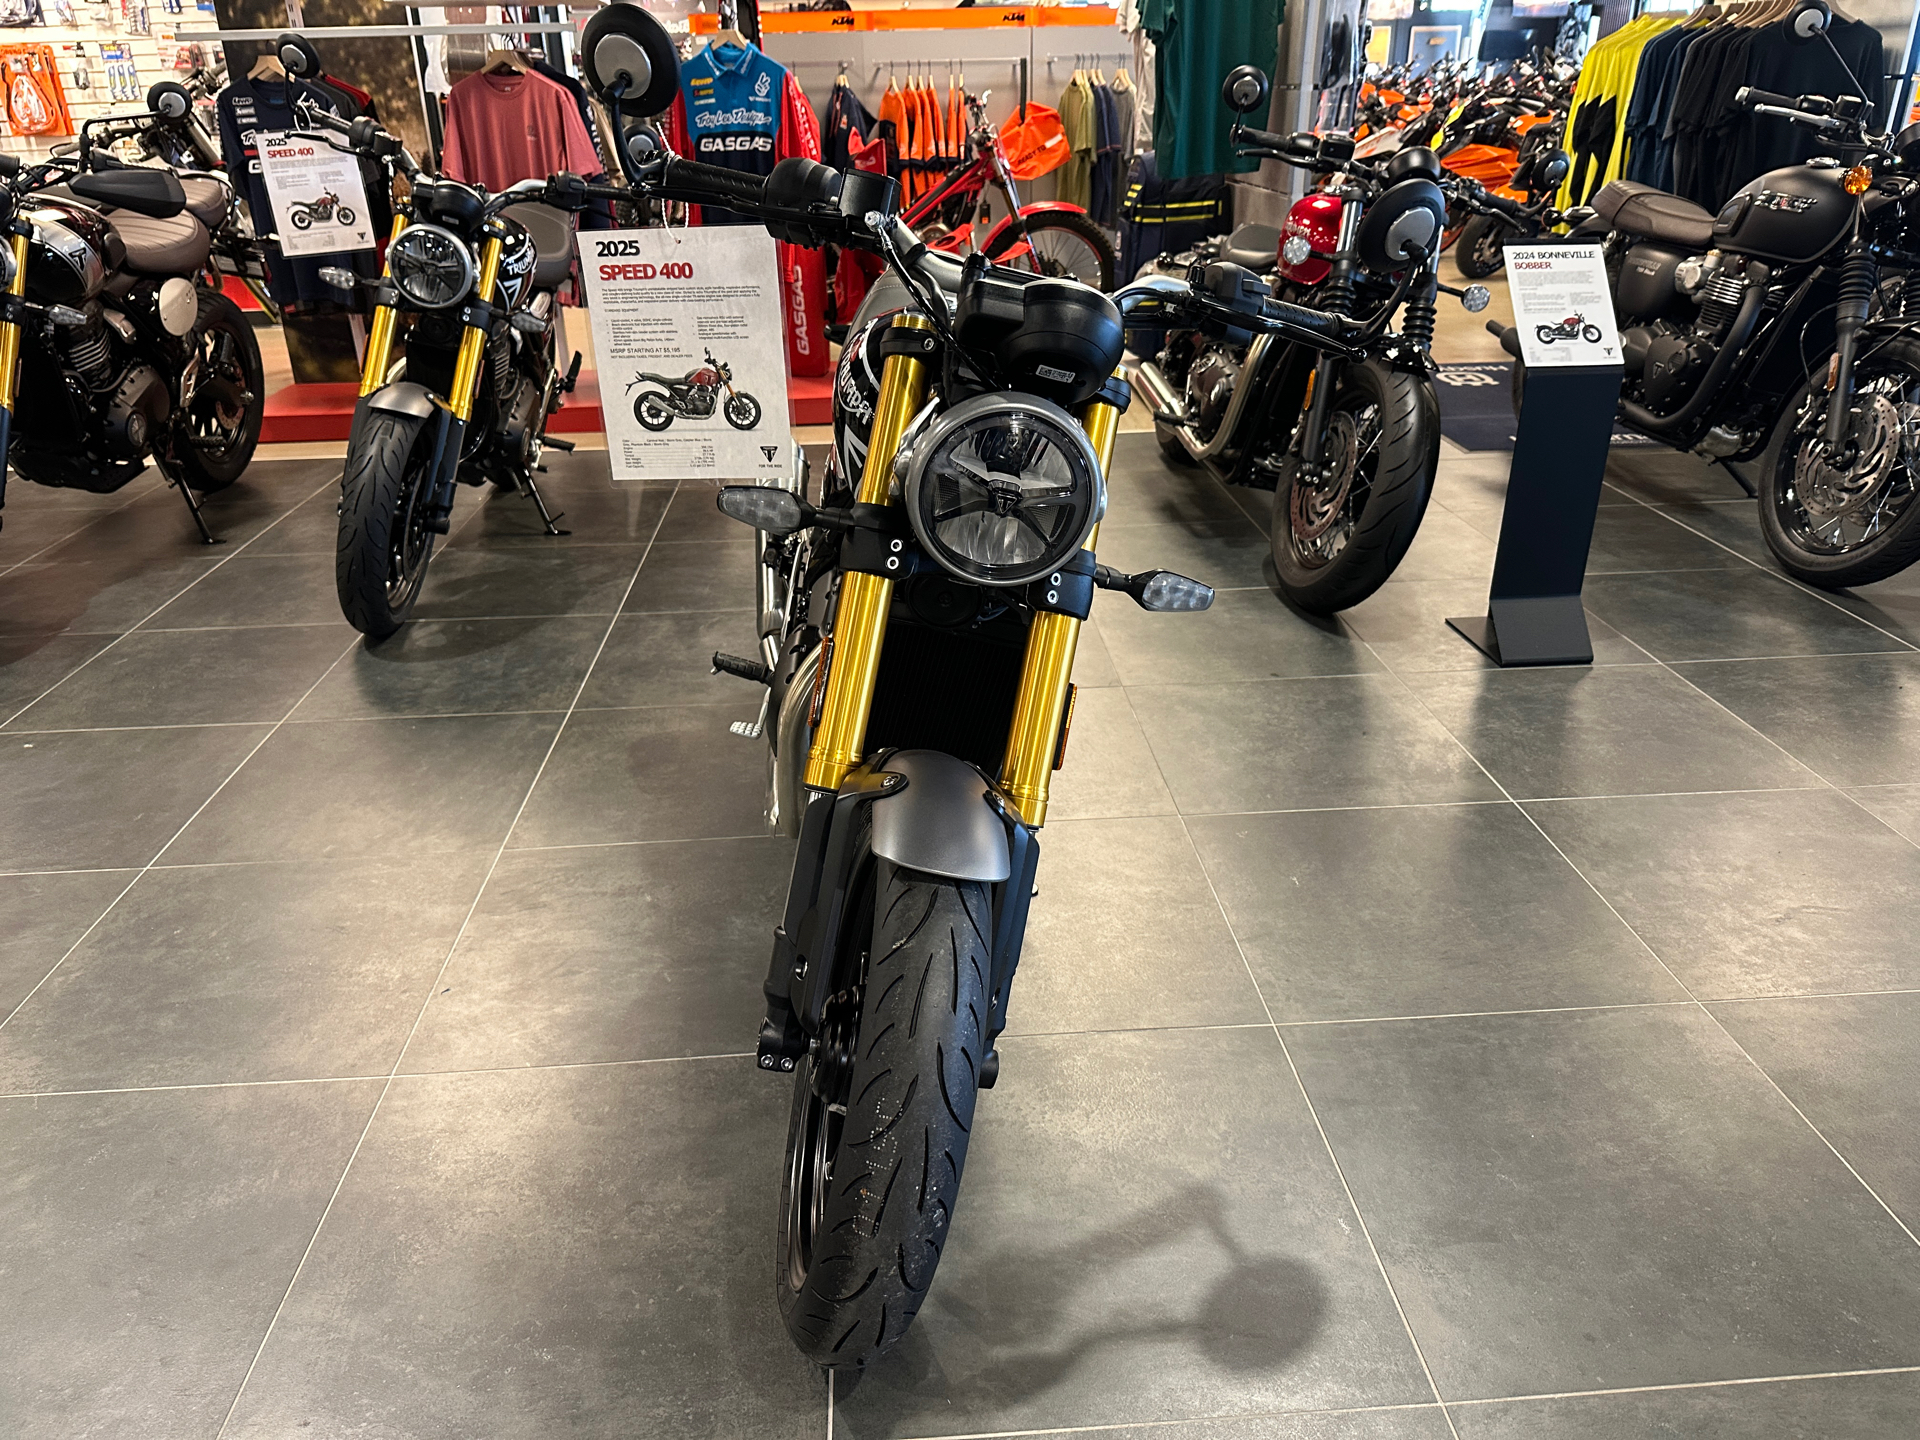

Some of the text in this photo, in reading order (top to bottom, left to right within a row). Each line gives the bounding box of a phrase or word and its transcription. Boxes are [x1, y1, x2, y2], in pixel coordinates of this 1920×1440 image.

[831, 16, 854, 26] KTM
[1002, 13, 1025, 22] KTM
[695, 108, 772, 128] Troy Lee Designs
[265, 138, 287, 147] 2025
[700, 136, 773, 152] GASGAS
[267, 148, 314, 158] SPEED 400
[1036, 144, 1046, 153] TO
[596, 240, 640, 257] 2025
[1512, 251, 1595, 260] 2024 BONNEVILLE
[599, 262, 693, 281] SPEED 400
[793, 265, 810, 356] GASGAS
